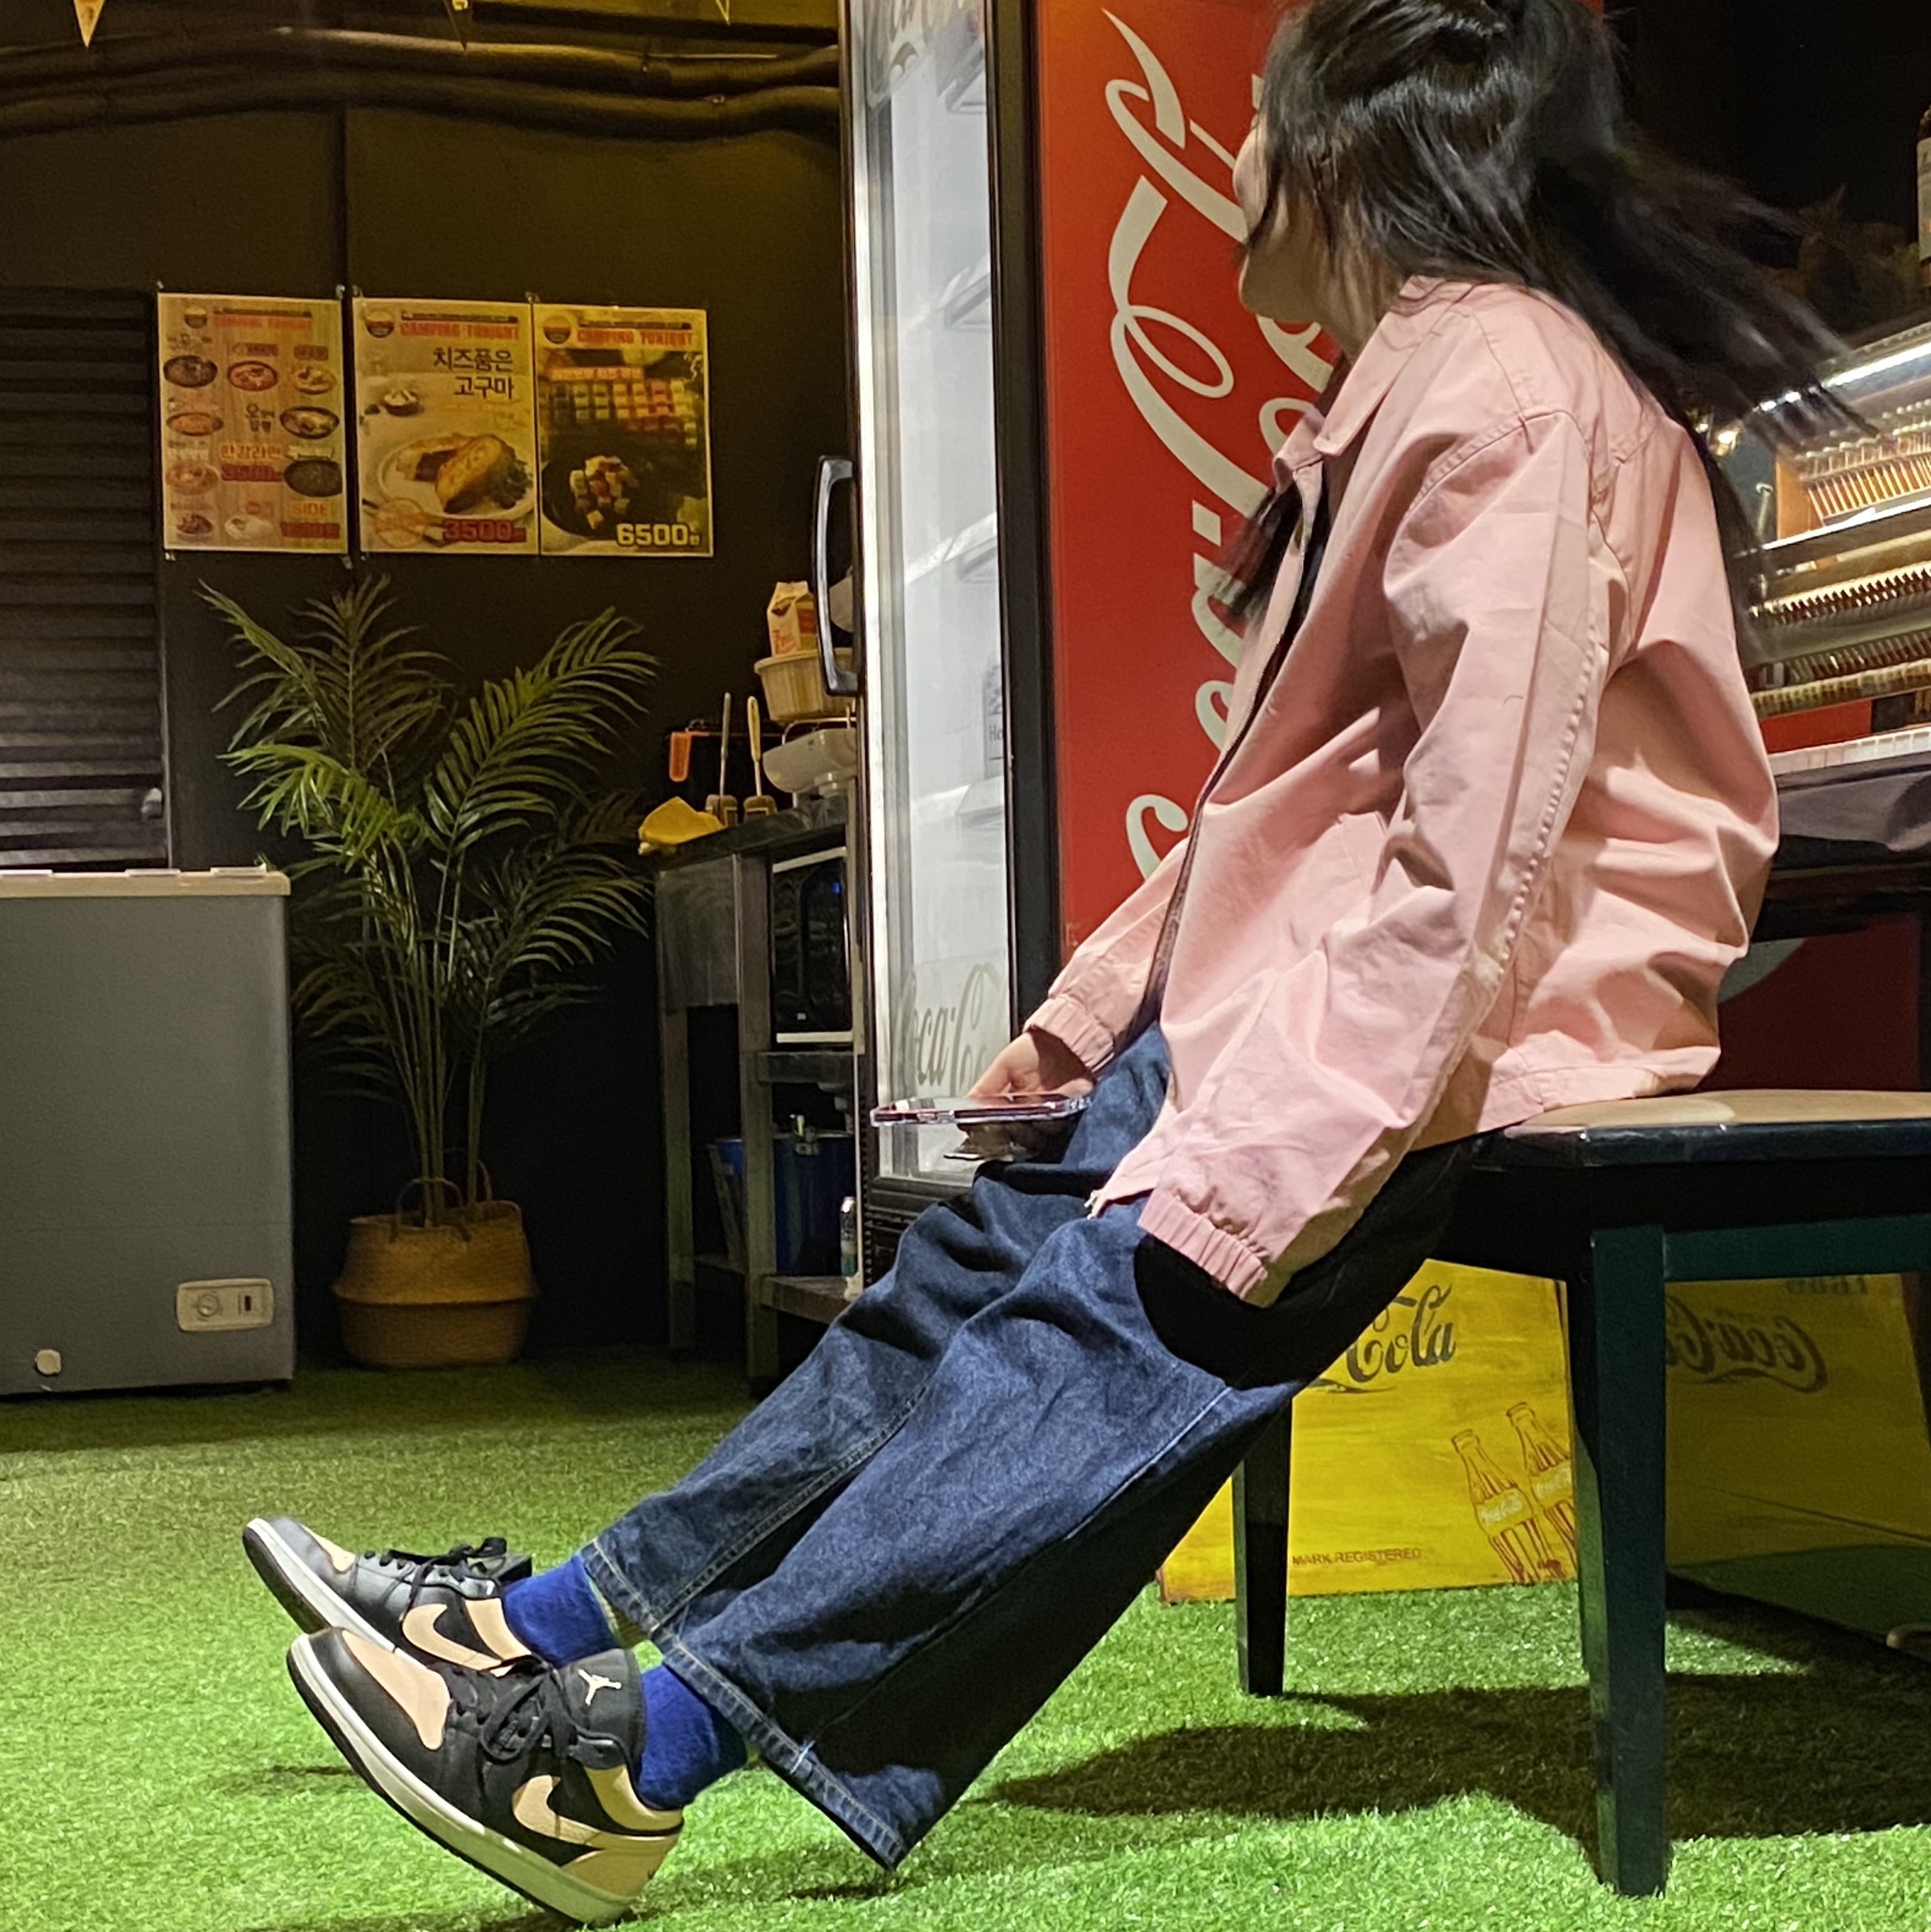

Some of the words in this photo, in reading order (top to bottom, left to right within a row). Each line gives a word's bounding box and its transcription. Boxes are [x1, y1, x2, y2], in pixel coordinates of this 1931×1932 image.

[432, 346, 514, 372] 치즈품은
[453, 375, 514, 399] 고구마
[443, 519, 526, 542] 3500
[616, 523, 700, 546] 6500
[1292, 1552, 1332, 1566] MARK
[1335, 1547, 1421, 1563] REGISTERED
